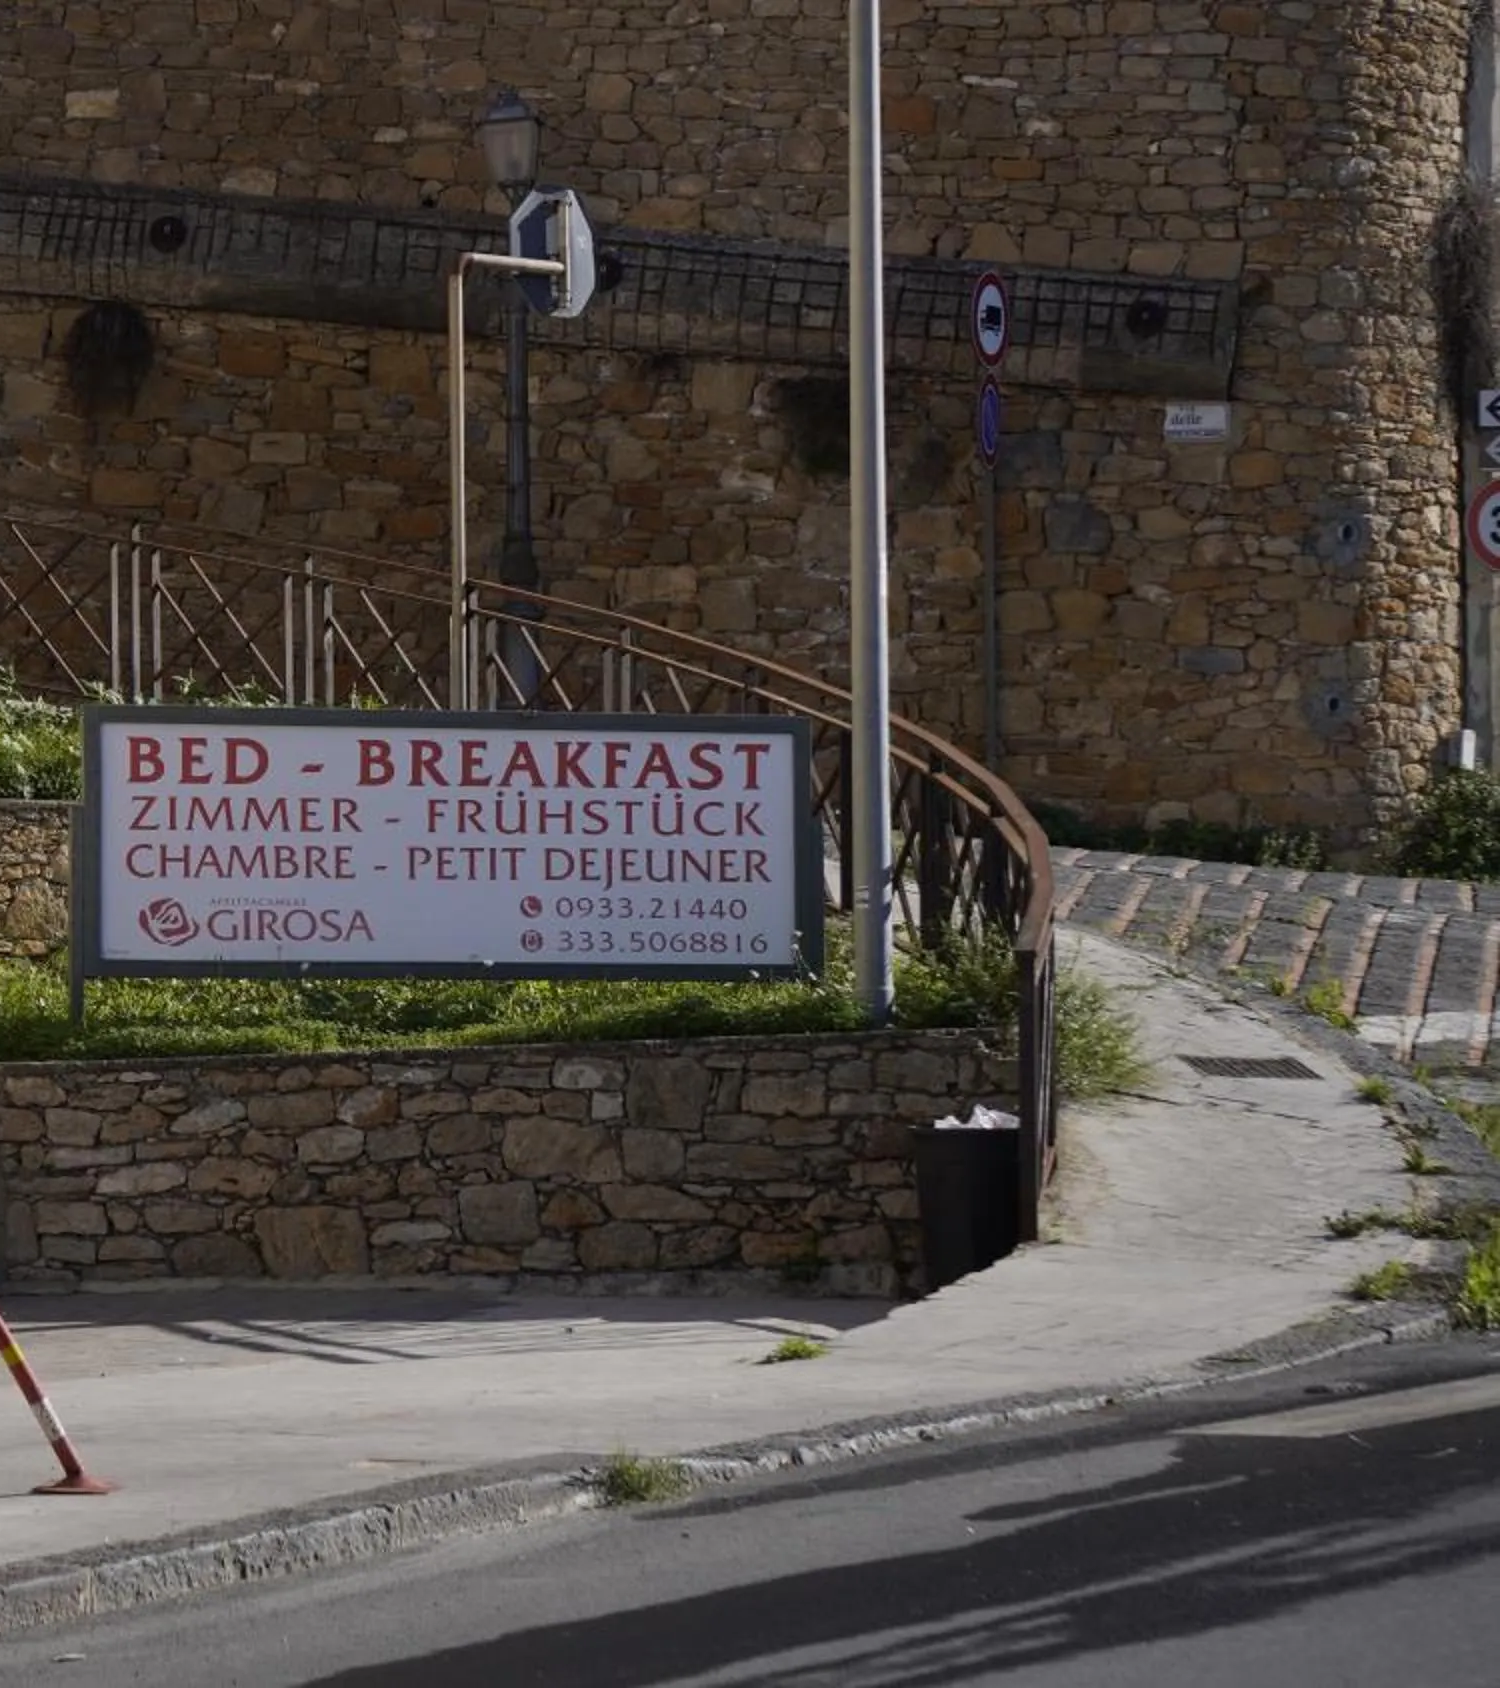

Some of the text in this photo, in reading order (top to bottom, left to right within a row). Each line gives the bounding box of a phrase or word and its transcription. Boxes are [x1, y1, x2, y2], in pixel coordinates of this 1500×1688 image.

[126, 736, 270, 785] BED
[356, 738, 772, 790] BREAKFAST
[128, 796, 363, 833] ZIMMER
[427, 790, 766, 837] FRÜHSTÜCK
[125, 843, 356, 879] CHAMBRE
[407, 846, 527, 881] PETIT
[544, 848, 773, 892] DEJEUNER
[206, 908, 375, 943] GIROSA
[555, 897, 748, 920] 0933.21440
[557, 930, 769, 955] 333.5068816
